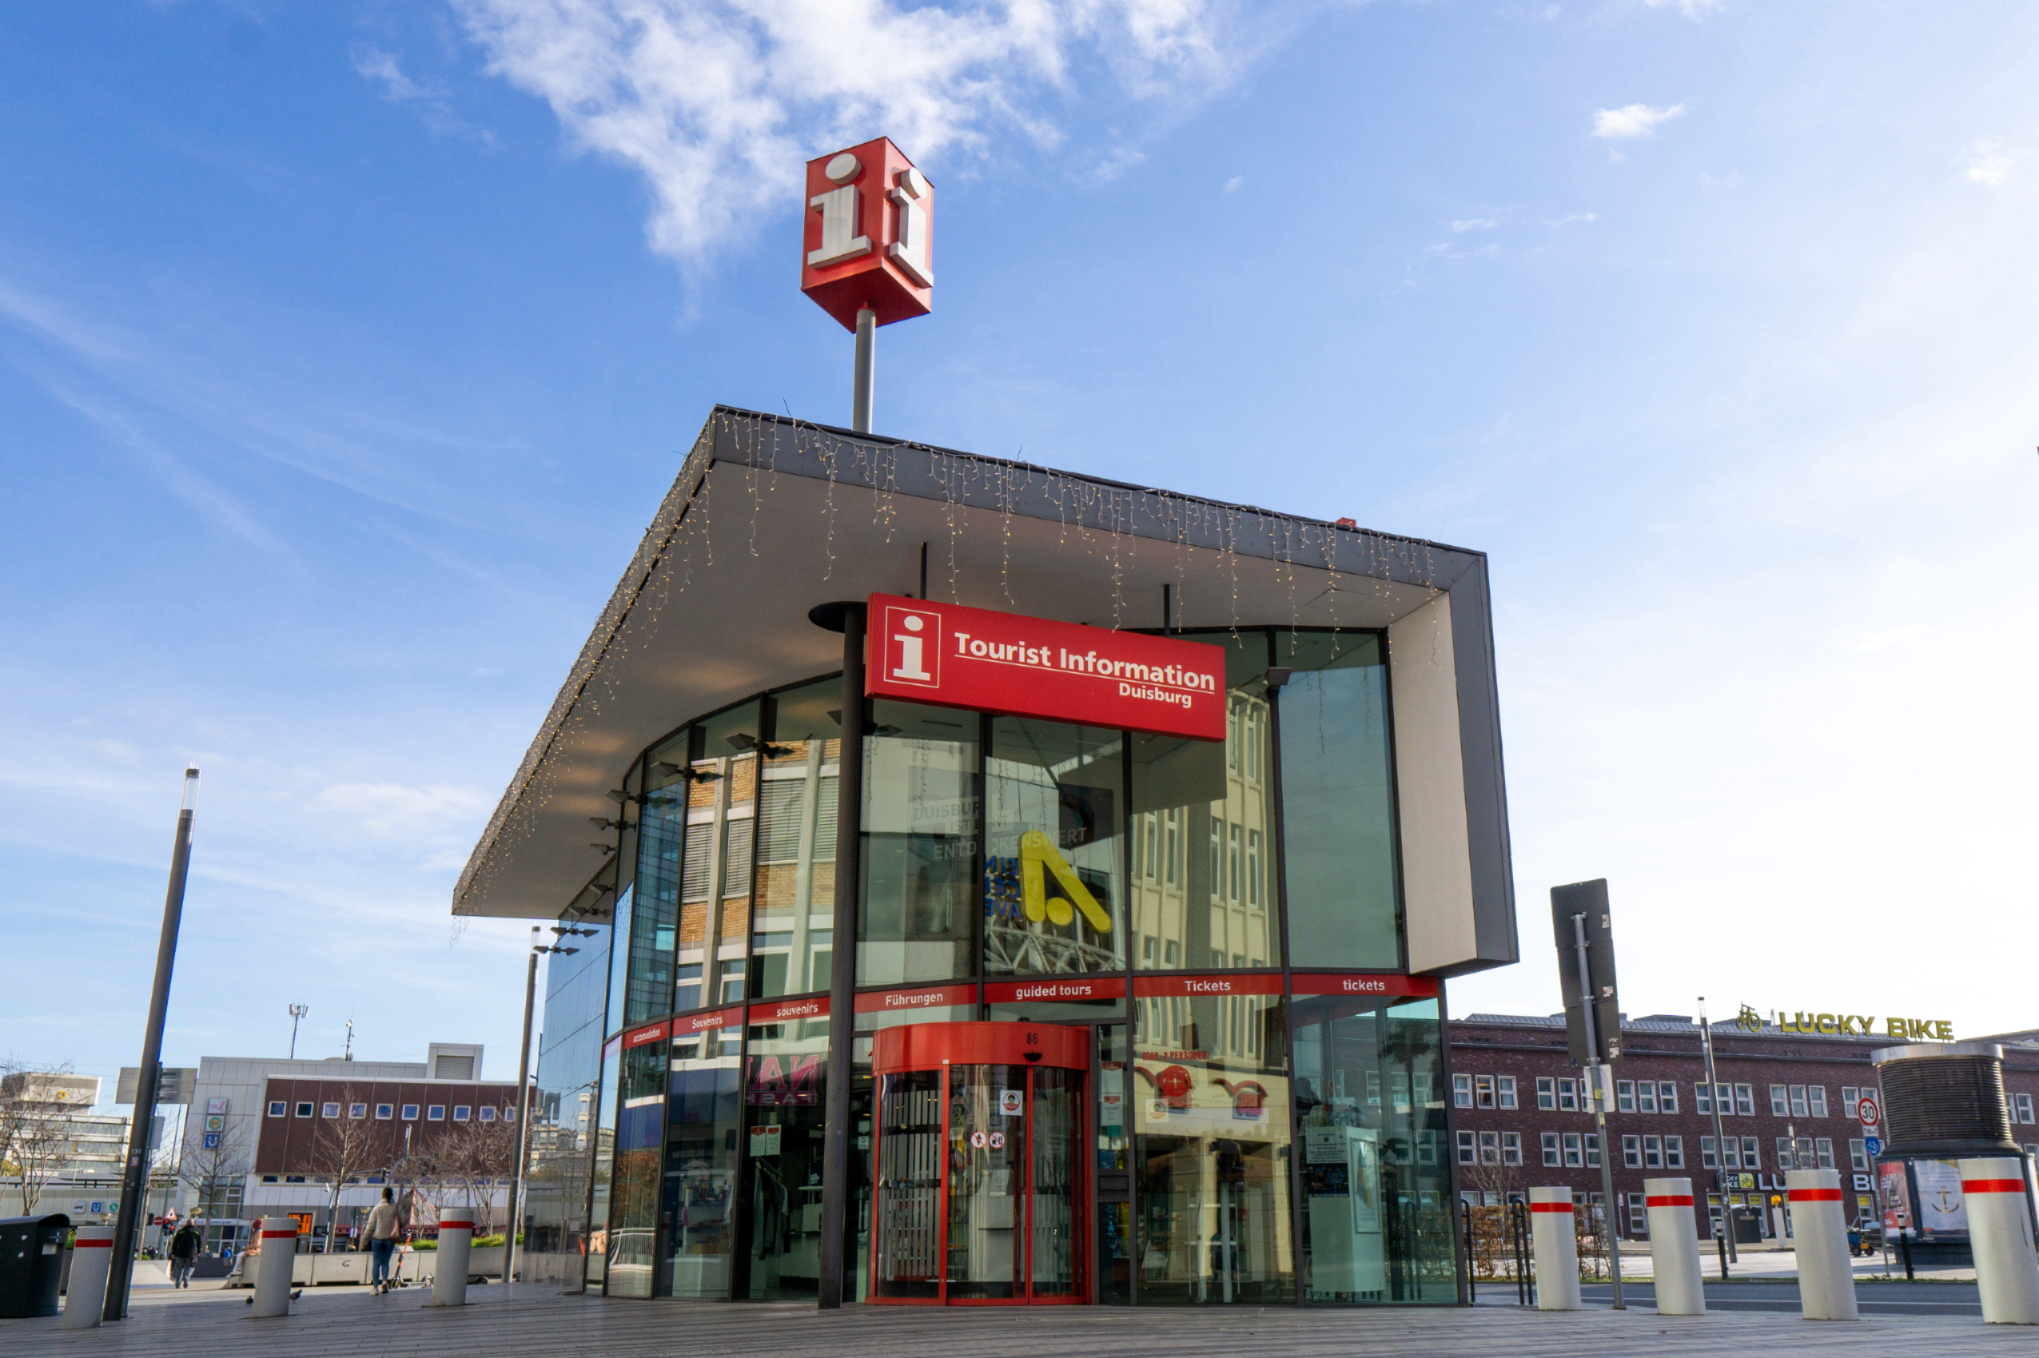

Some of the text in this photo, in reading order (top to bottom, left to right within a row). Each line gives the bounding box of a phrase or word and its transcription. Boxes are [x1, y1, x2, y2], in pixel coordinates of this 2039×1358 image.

[954, 632, 1215, 691] Tourist Information
[1119, 683, 1192, 708] Duisburg
[913, 801, 979, 821] DUISBUR
[1184, 980, 1231, 992] Tickets
[1342, 979, 1386, 991] tickets
[885, 993, 943, 1006] Führungen
[1016, 985, 1092, 1000] guided tours
[776, 1003, 819, 1017] souvenirs
[692, 1015, 723, 1029] Souvenirs
[1778, 1011, 1955, 1040] LUCKY BIKE
[1026, 1033, 1038, 1045] 86
[1163, 1052, 1168, 1061] 2
[1170, 1050, 1207, 1060] PERSONEN
[1862, 1105, 1874, 1119] 30
